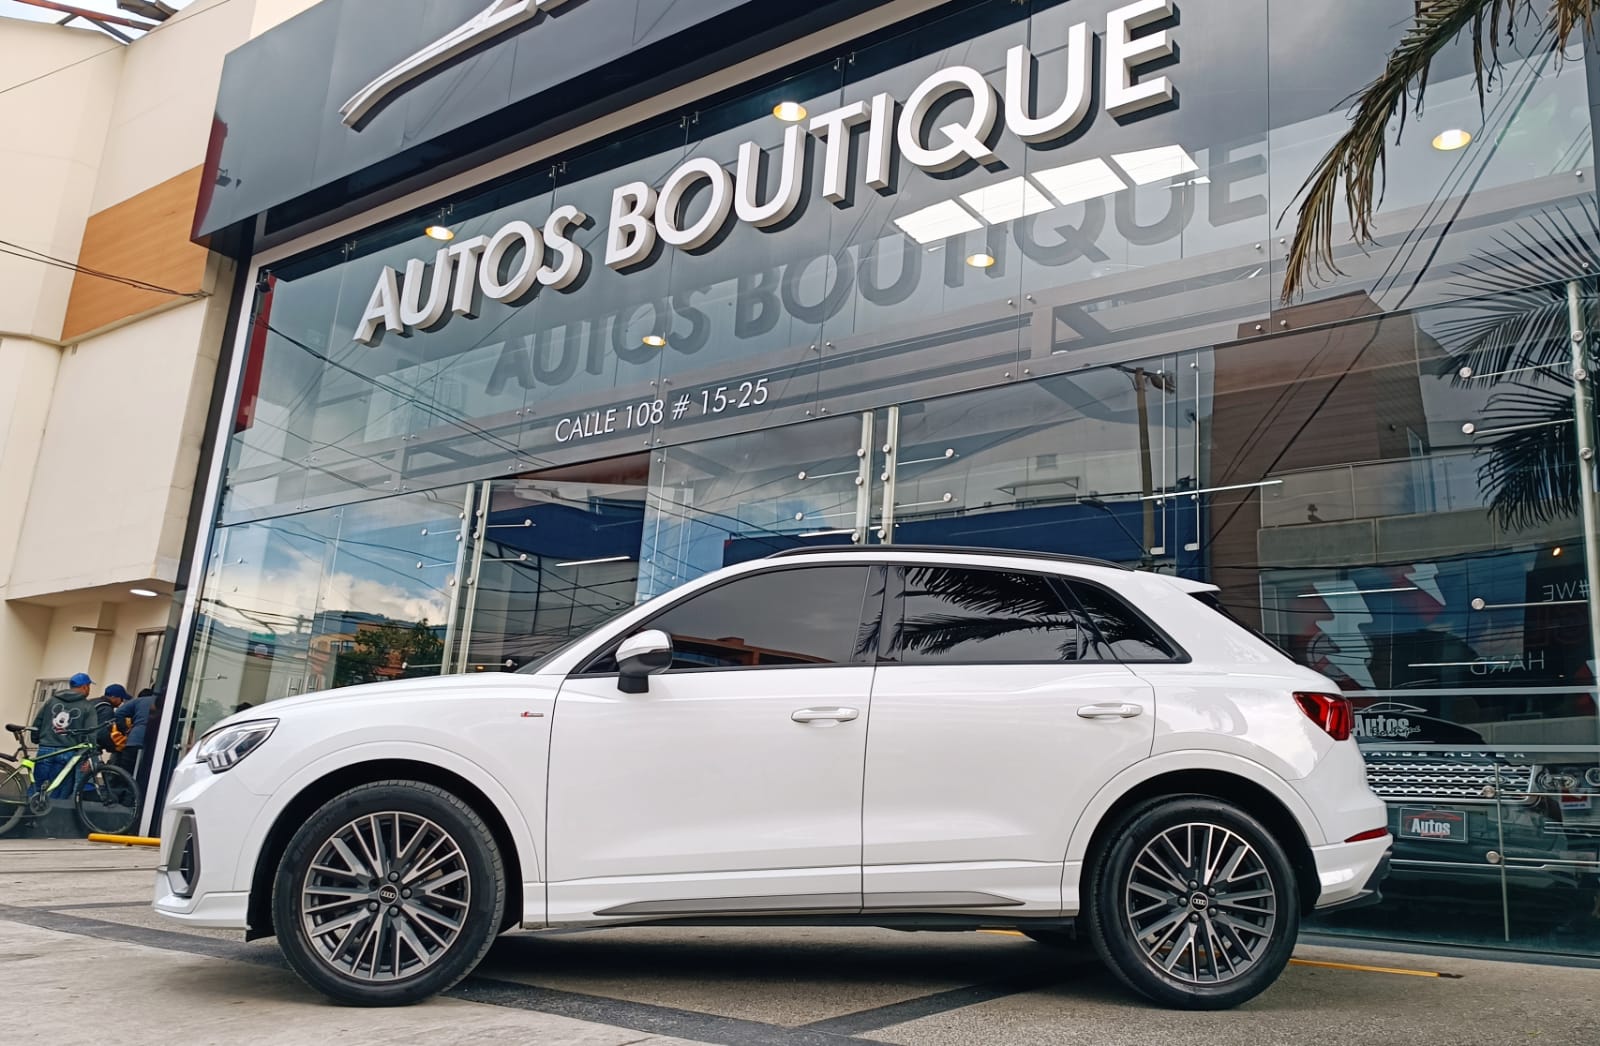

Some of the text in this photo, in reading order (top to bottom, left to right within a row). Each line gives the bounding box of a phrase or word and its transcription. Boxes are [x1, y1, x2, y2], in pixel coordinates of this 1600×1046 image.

[353, 0, 1177, 346] AUTOS BOUTIQUE
[554, 377, 769, 443] CALLE 108 # 15-25
[1353, 714, 1410, 738] Autos
[1410, 817, 1452, 836] Autos
